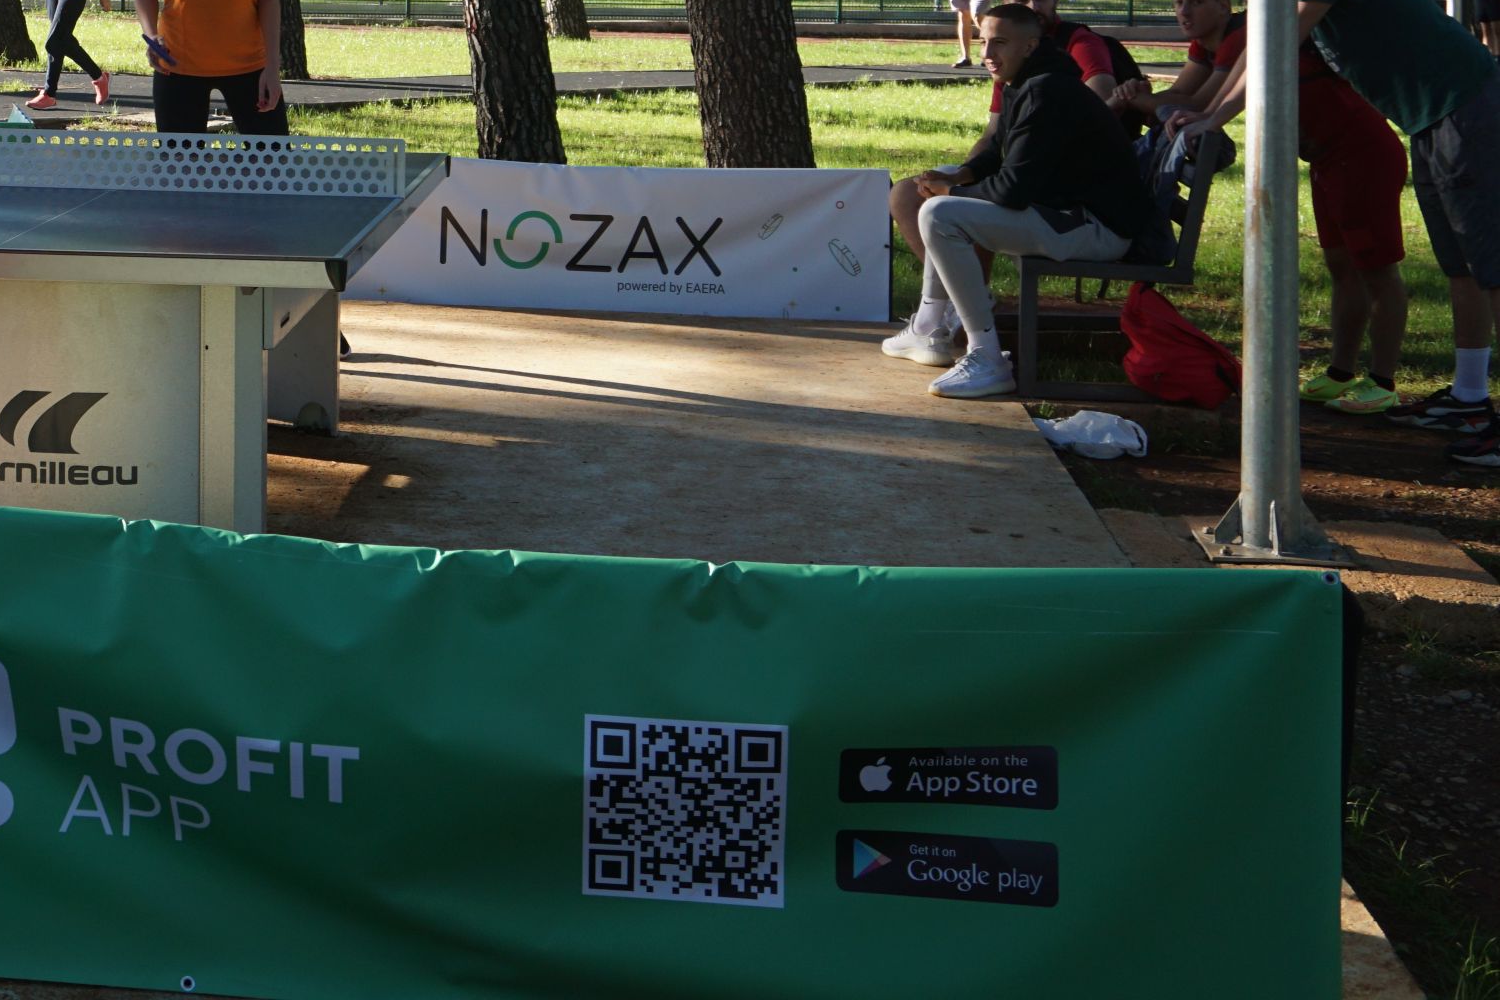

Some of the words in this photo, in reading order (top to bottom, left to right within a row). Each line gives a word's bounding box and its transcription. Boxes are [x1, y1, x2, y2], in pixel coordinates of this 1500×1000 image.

[439, 205, 724, 277] NOZAX
[617, 281, 666, 293] powered
[669, 281, 682, 296] by
[686, 282, 726, 295] EAERA
[57, 706, 360, 804] PROFIT
[908, 755, 976, 767] Available
[980, 756, 999, 766] on
[1004, 754, 1028, 767] the
[905, 771, 961, 797] App
[965, 770, 1038, 796] Store
[58, 774, 211, 841] APP
[909, 843, 929, 855] Get
[931, 844, 939, 856] it
[942, 847, 956, 857] on
[907, 859, 990, 892] Google
[998, 868, 1043, 895] play
